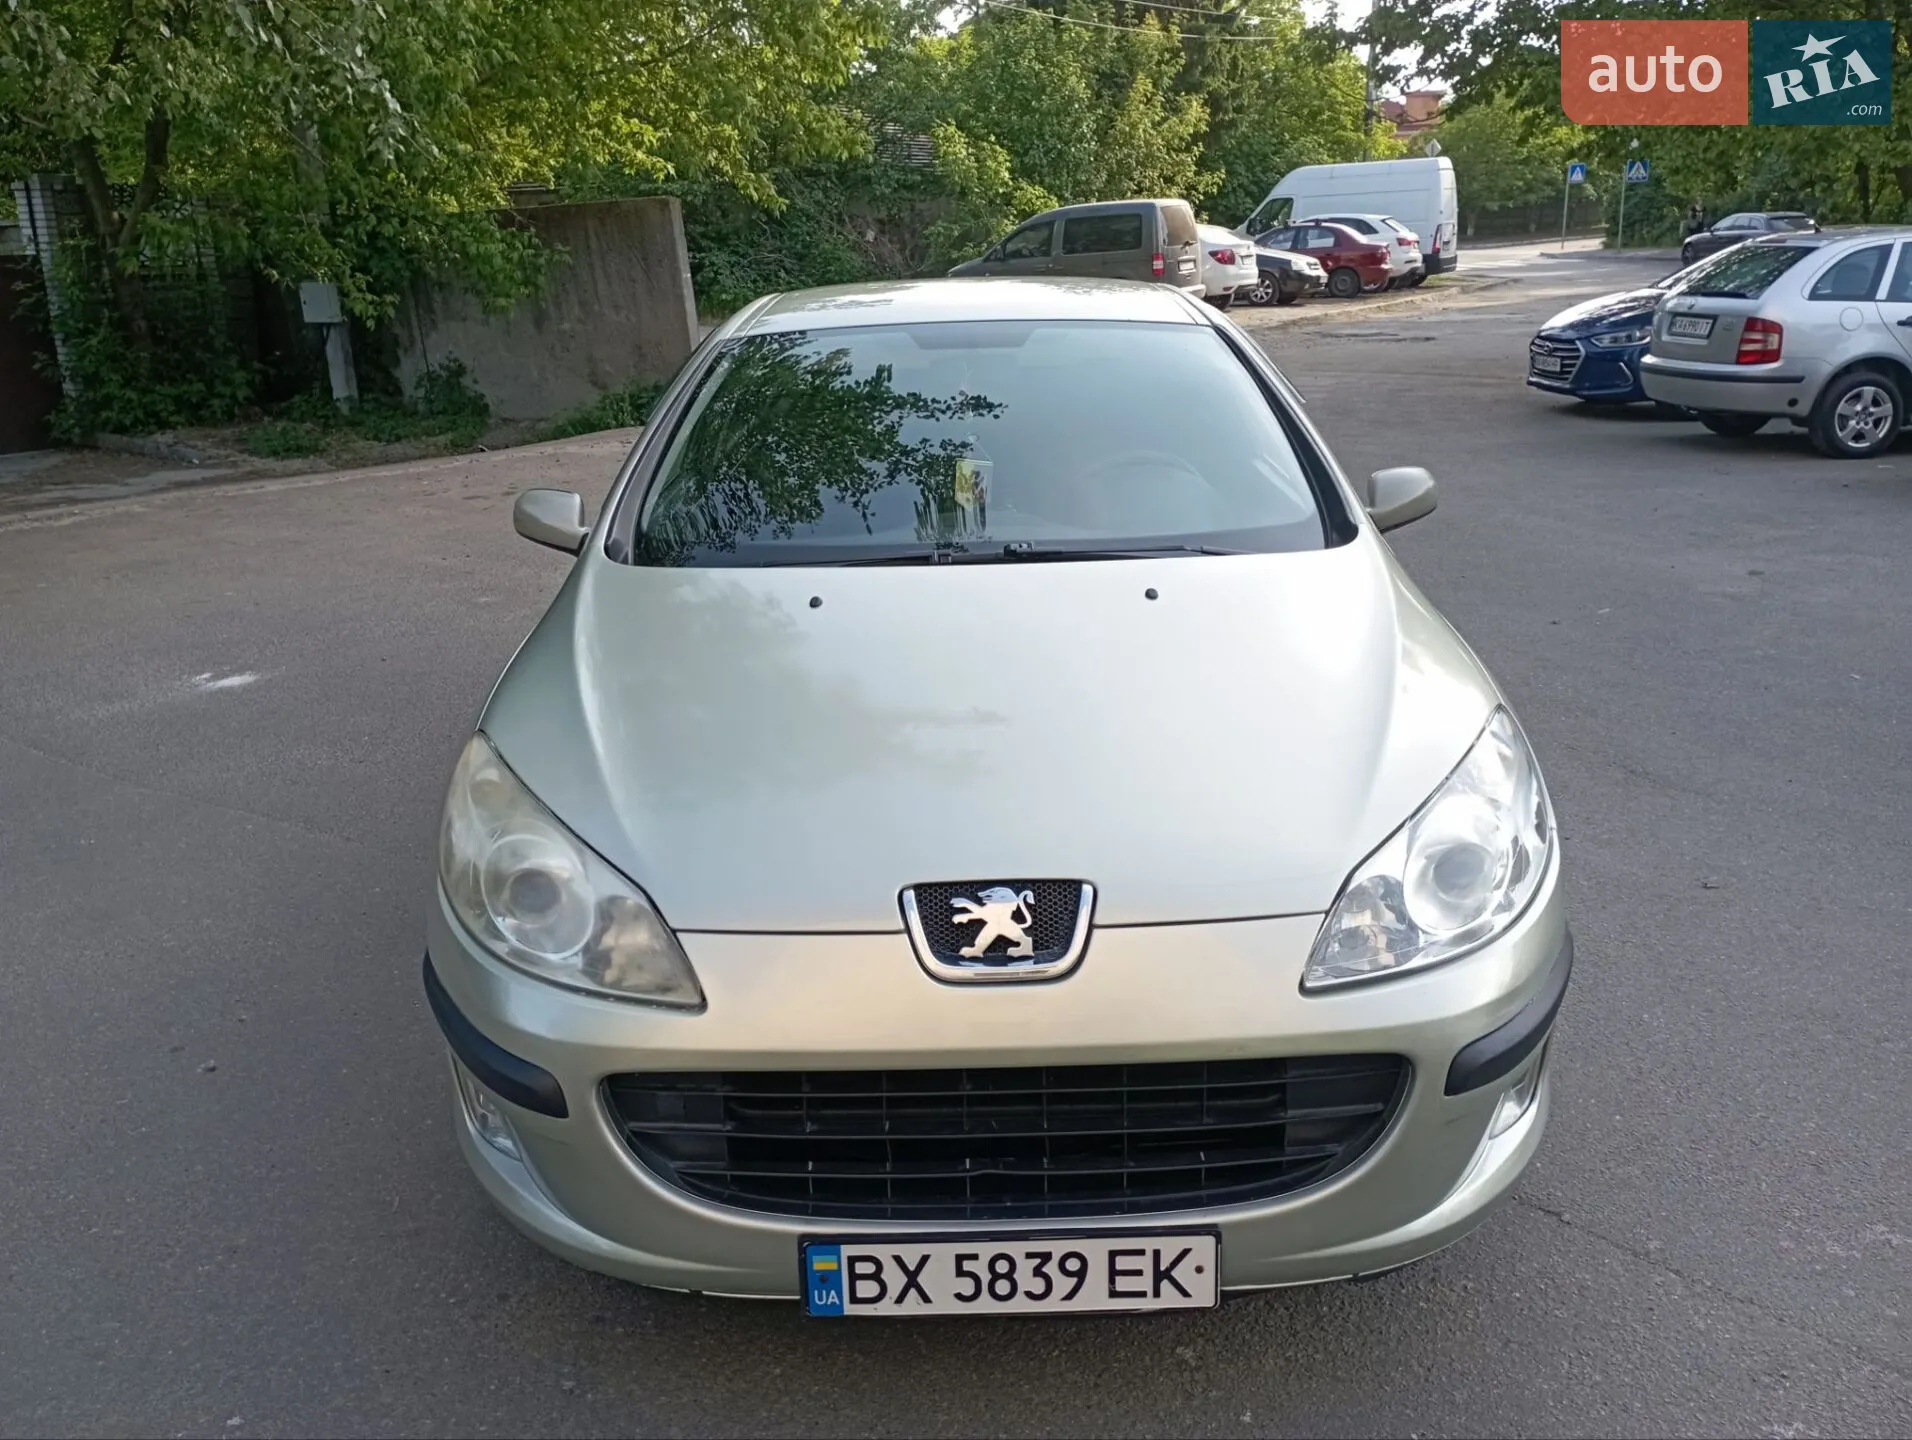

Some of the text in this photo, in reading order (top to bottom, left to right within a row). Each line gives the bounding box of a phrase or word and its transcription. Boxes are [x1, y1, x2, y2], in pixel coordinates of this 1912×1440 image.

[846, 1247, 1194, 1306] BX 5839 EK
[814, 1290, 840, 1306] UA
